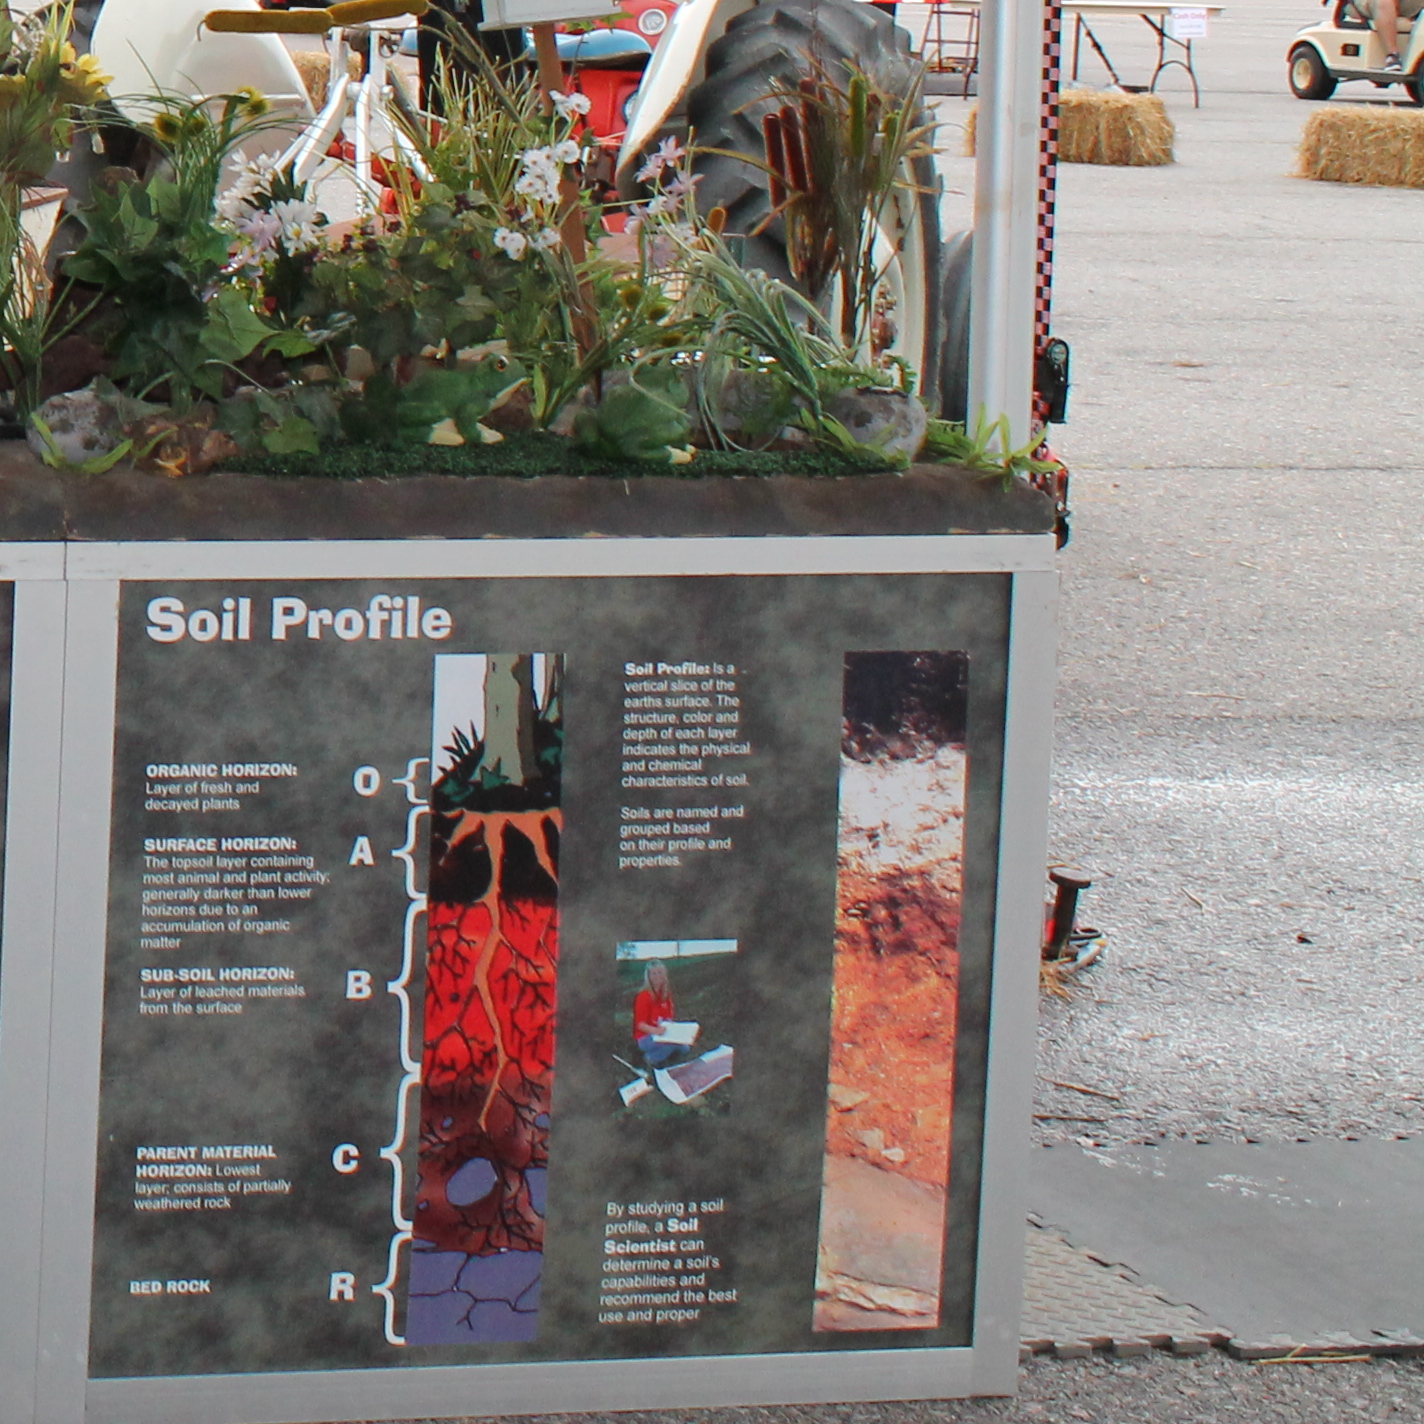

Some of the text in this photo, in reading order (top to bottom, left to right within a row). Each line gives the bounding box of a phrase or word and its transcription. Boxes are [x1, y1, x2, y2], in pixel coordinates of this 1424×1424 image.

[146, 594, 452, 642] Soil Profile
[624, 661, 711, 676] Soil Profile:
[146, 763, 298, 778] ORGANIC HORIZON:
[353, 766, 381, 797] O
[144, 836, 297, 852] SURFACE HORIZON:
[349, 836, 375, 866] A
[140, 967, 295, 983] SUB-SOIL HORIZON:
[346, 970, 372, 999] B
[136, 1144, 277, 1161] PARENT MATERIAL
[332, 1143, 359, 1174] C
[136, 1163, 212, 1178] HORIZON:
[667, 1217, 699, 1233] Soil
[604, 1238, 677, 1255] Scientist
[129, 1279, 211, 1295] BED ROCK
[329, 1271, 355, 1301] R
